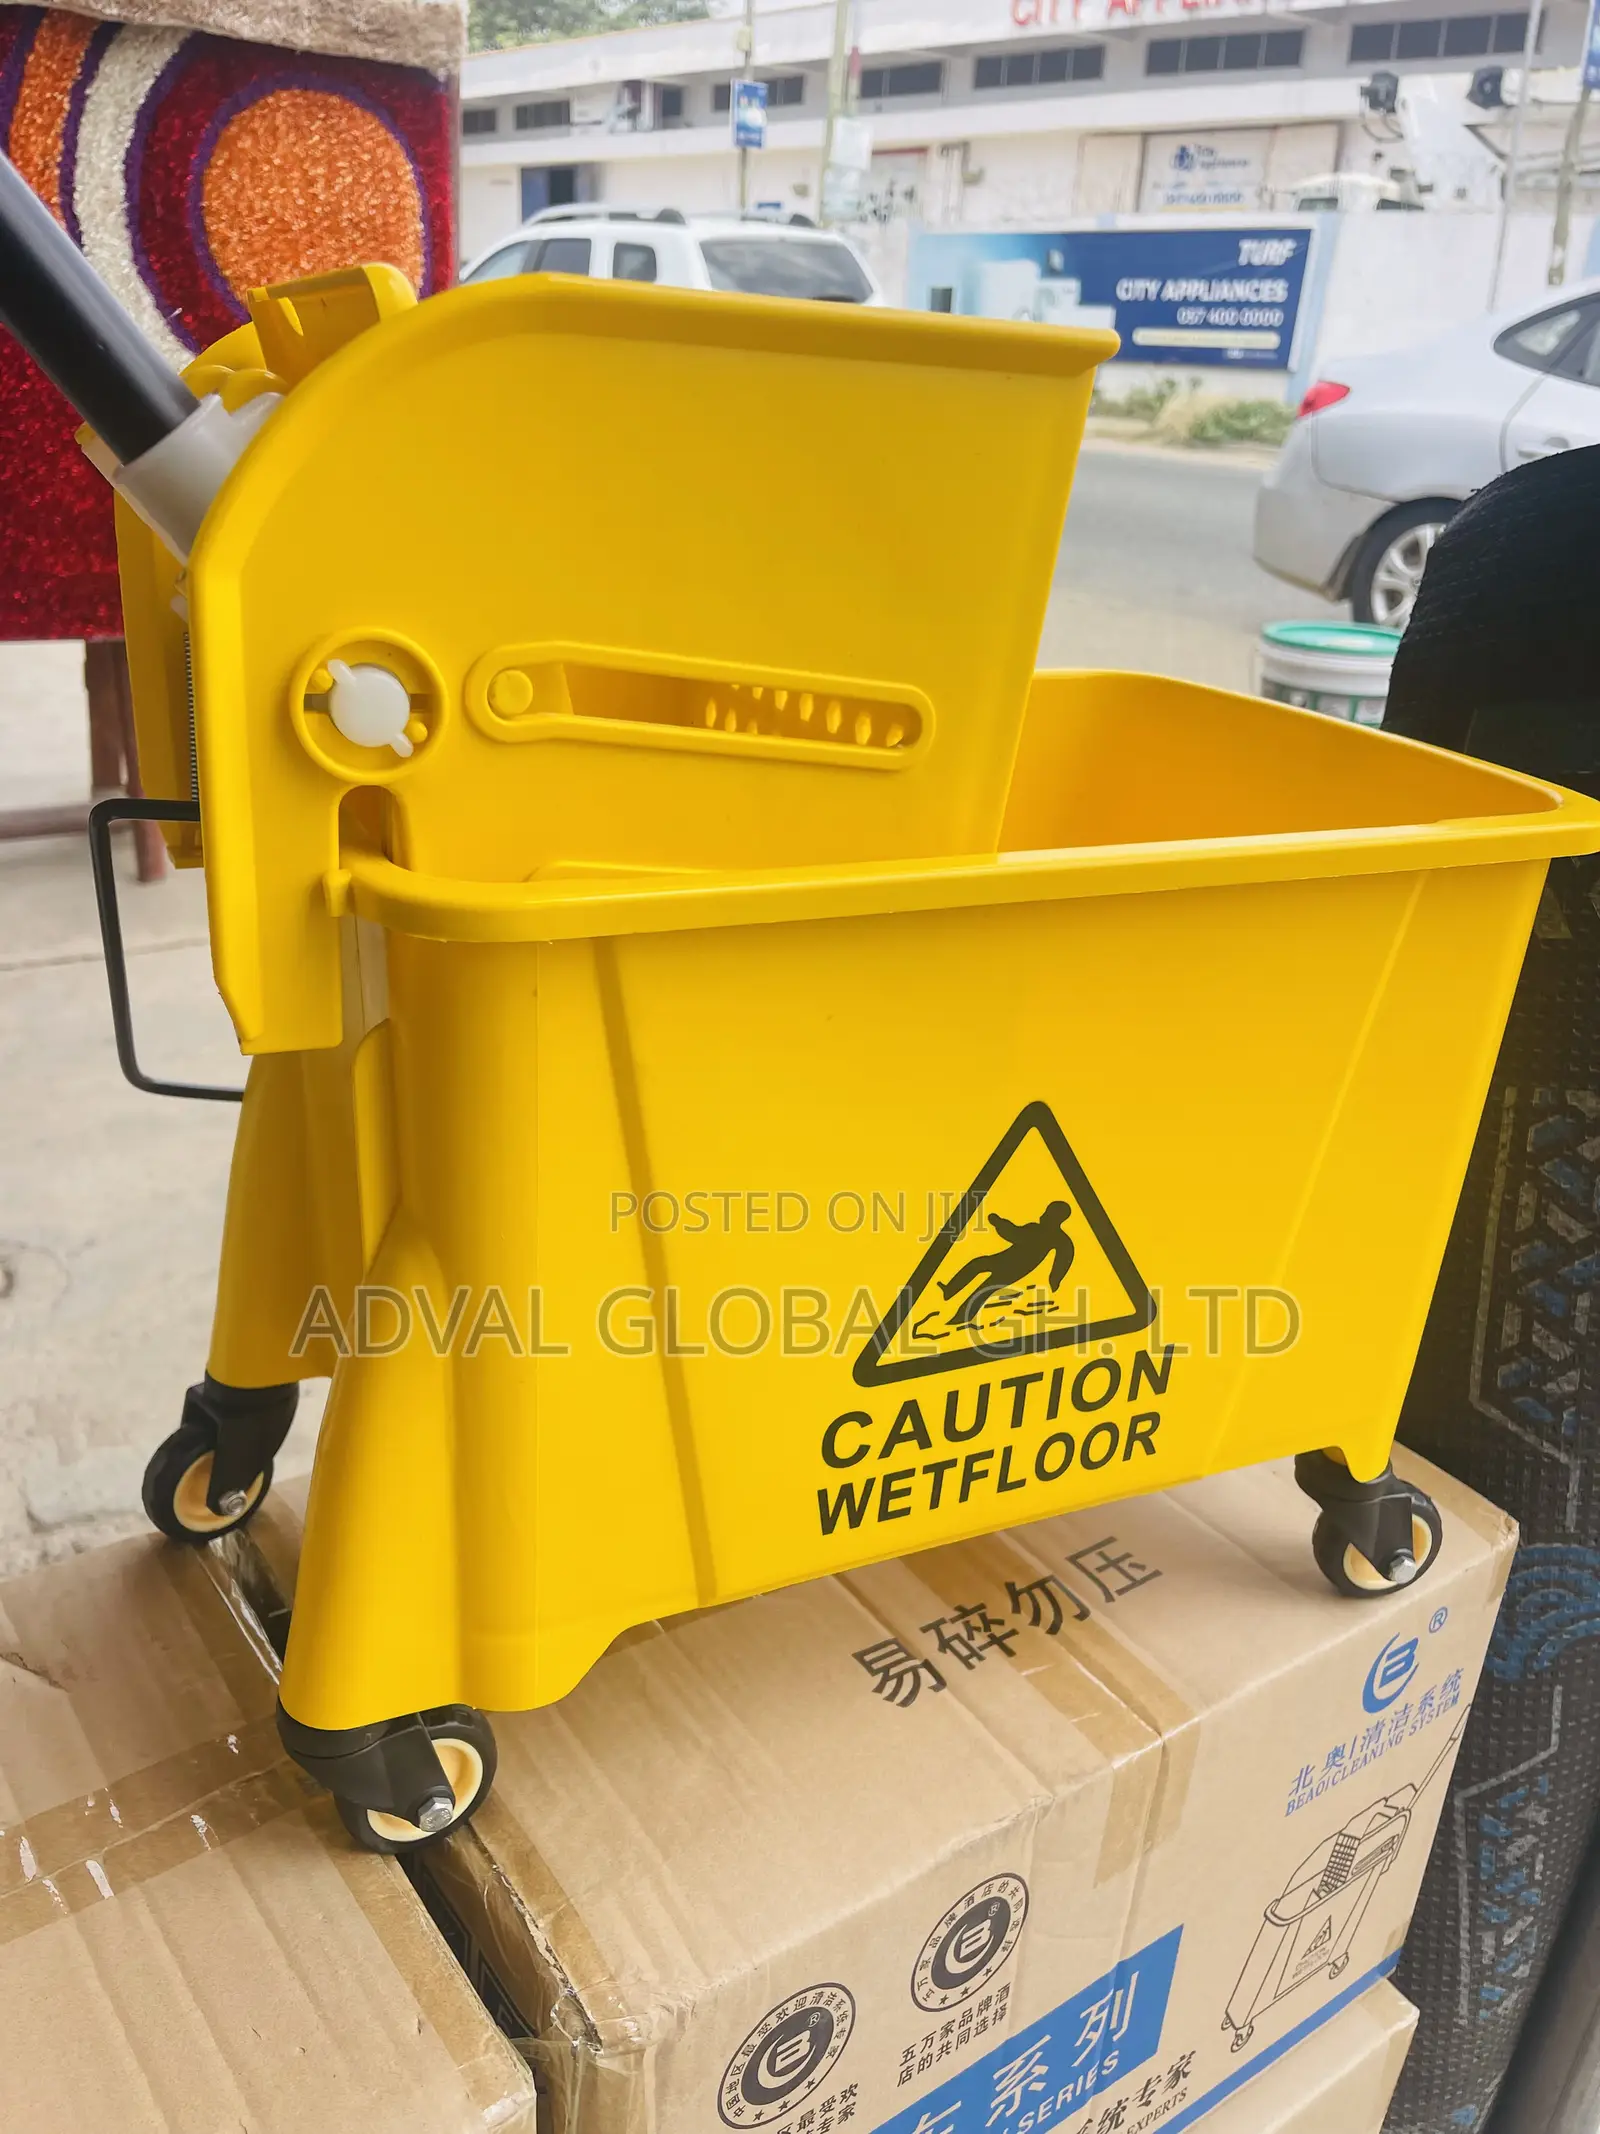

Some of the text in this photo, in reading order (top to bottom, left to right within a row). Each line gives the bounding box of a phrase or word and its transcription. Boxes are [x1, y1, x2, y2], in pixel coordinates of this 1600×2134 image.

[1116, 278, 1288, 303] CITY APPLIANCES
[1238, 239, 1297, 266] TURF
[820, 1343, 1175, 1469] CAUTION
[816, 1411, 1161, 1536] WETFLOOR
[850, 1536, 1163, 1708] 易碎勿压
[1407, 1690, 1461, 1737] SYSTEM
[896, 2002, 1009, 2088] 店的共同选择
[899, 1982, 1012, 2067] 五万家品牌酒
[1017, 2050, 1120, 2134] SERIES
[1126, 2086, 1189, 2134] EXPERTS
